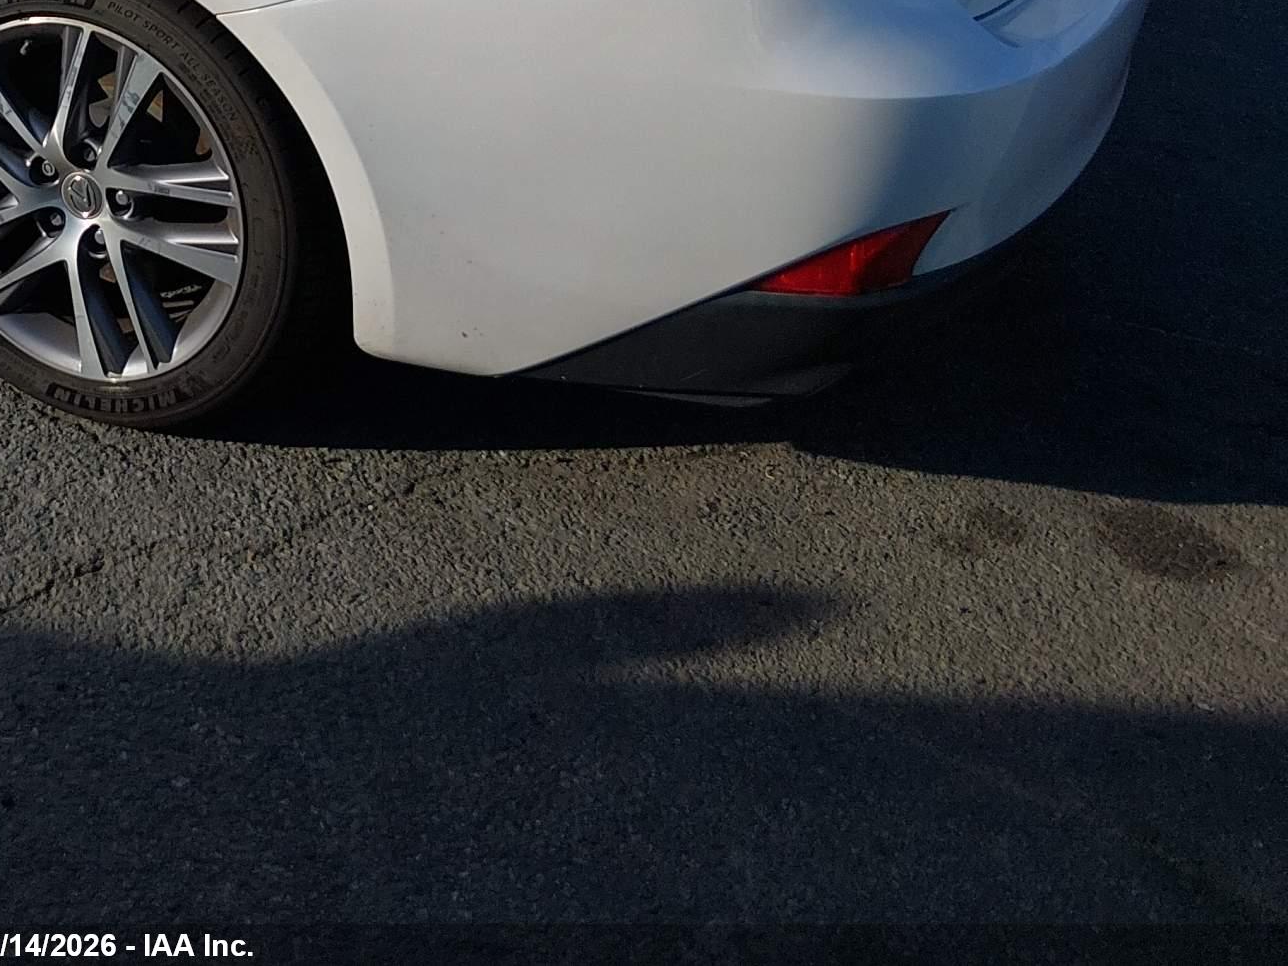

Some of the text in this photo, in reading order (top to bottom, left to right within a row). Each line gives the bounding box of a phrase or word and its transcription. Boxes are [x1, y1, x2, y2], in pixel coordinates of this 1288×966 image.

[107, 1, 141, 22] PILOT
[142, 17, 179, 50] SPORT
[181, 51, 202, 71] ALL
[201, 72, 239, 122] SEASON
[53, 386, 177, 413] MICHELIN
